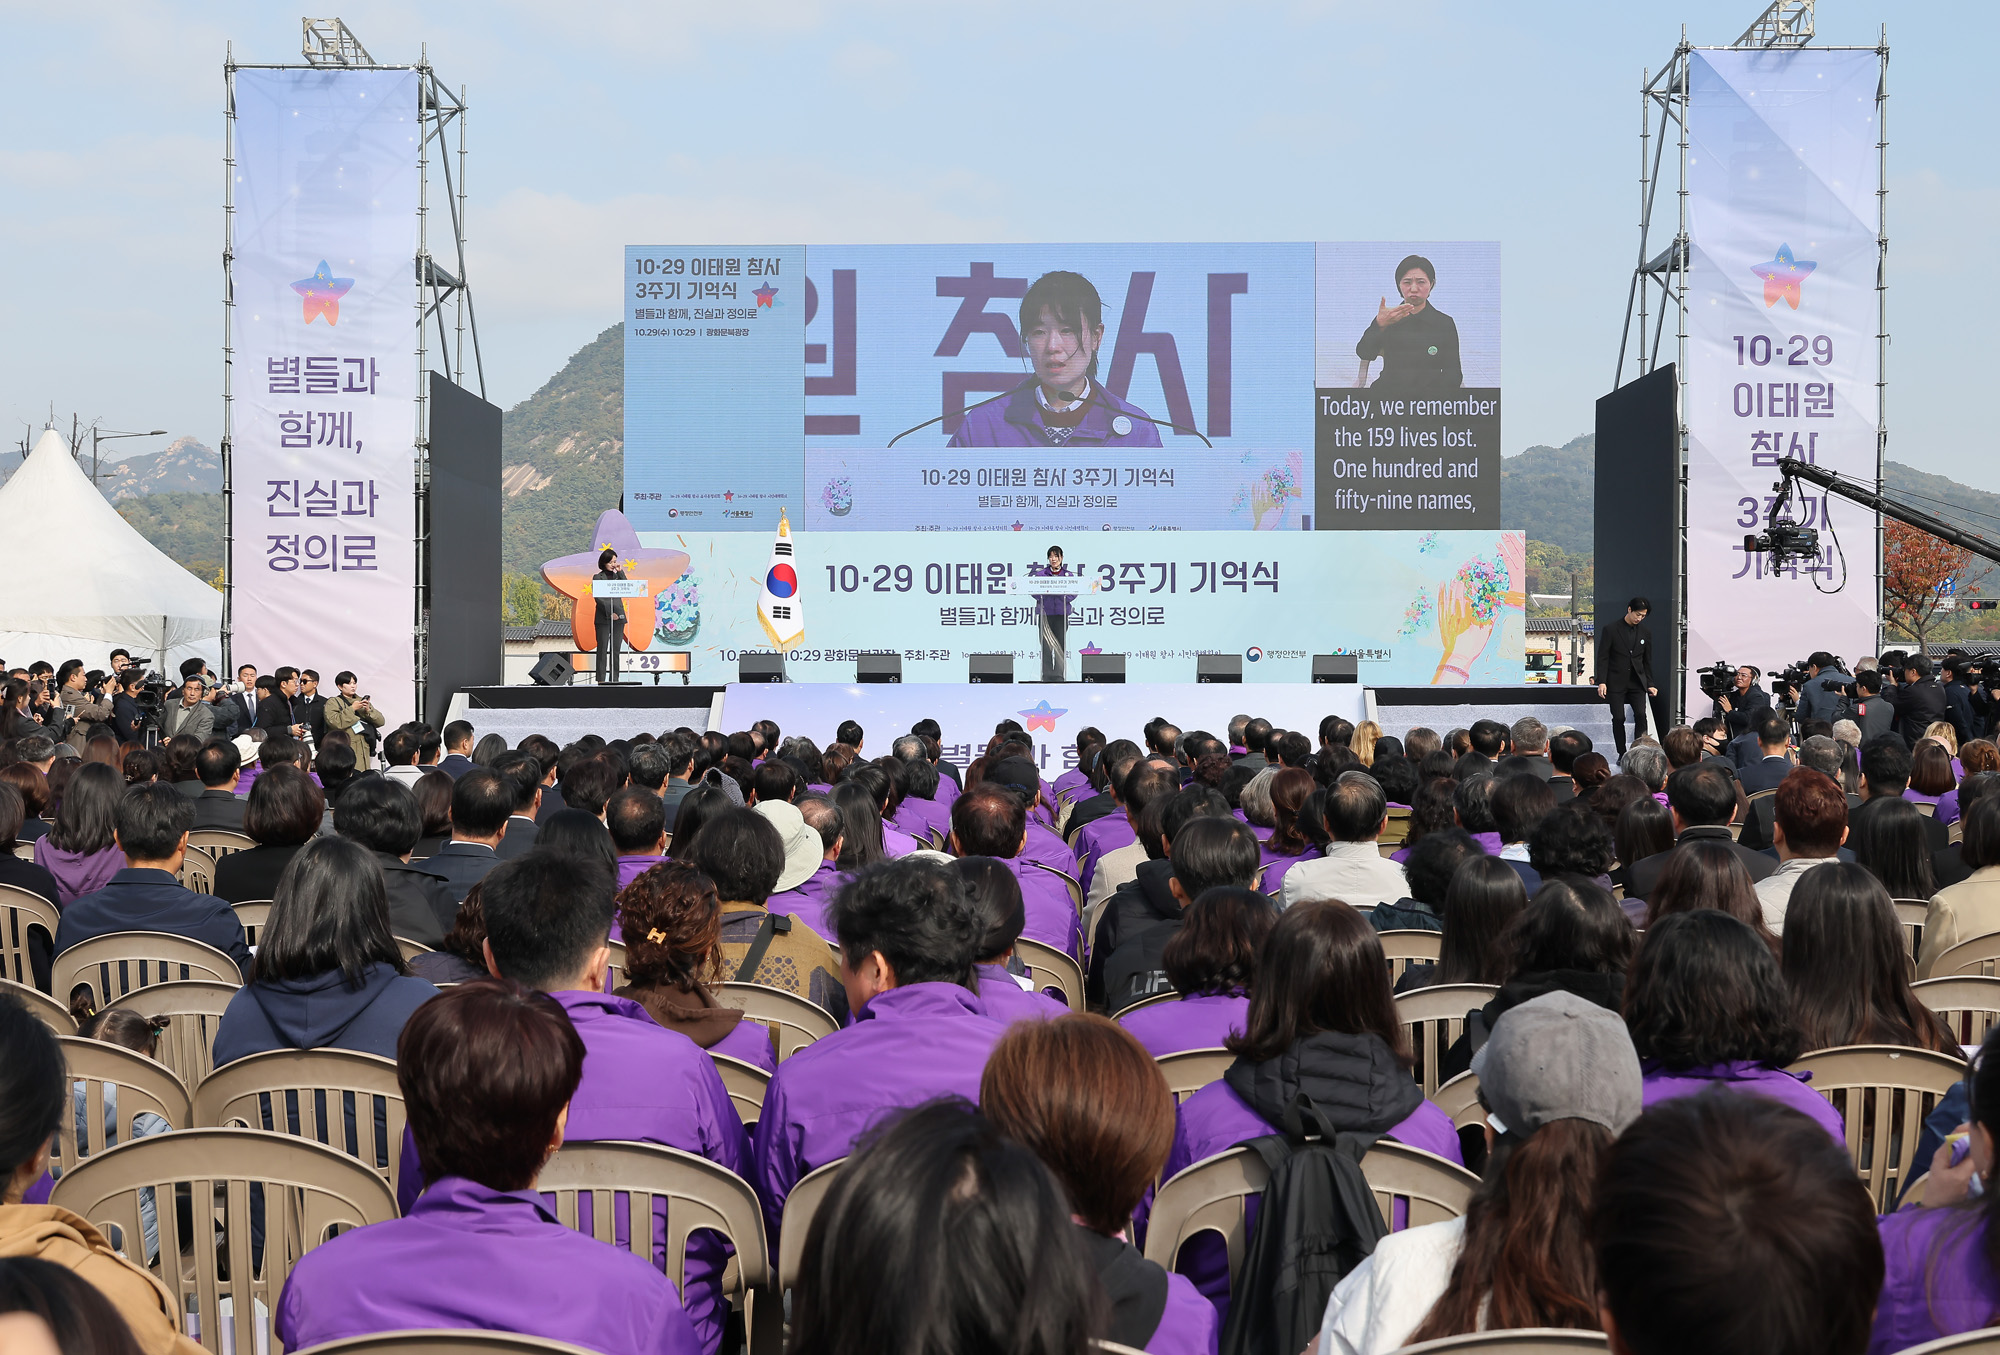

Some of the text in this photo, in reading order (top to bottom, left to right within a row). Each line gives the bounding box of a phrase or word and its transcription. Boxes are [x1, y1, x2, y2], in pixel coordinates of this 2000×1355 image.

[635, 257, 781, 276] 10·29 이태원 참사
[635, 282, 737, 300] 3주기 기억식
[635, 308, 758, 321] 별들과 함께, 진실과 정의로
[634, 328, 670, 337] 10.29(수)
[672, 328, 696, 337] 10:29
[1732, 335, 1833, 366] 10·29
[266, 356, 380, 395] 별들과
[1320, 395, 1497, 420] Today, we remember
[1733, 382, 1834, 418] 이태원
[278, 410, 363, 455] 함께,
[1335, 426, 1477, 447] the 159 lives lost.
[1750, 430, 1819, 467] 참사
[921, 467, 1175, 487] 10·29 이태원 참사 3주기 기억식
[1333, 457, 1478, 478] One hundred and
[266, 480, 379, 518] 진실과
[978, 496, 1118, 509] 별들과 함께, 진실과 정의로
[1335, 488, 1476, 513] fifty-nine names,
[1737, 497, 1827, 532] 3주기
[266, 535, 379, 573] 정의로
[825, 564, 913, 593] 10·29
[925, 563, 1013, 595] 이태원
[1097, 562, 1176, 594] 3주기
[1190, 561, 1279, 594] 기억식
[939, 606, 995, 626] 별들과
[1109, 606, 1165, 626] 정의로
[639, 655, 660, 669] 29
[904, 650, 951, 661] 주최·주관
[1266, 650, 1307, 659] 행정안전부
